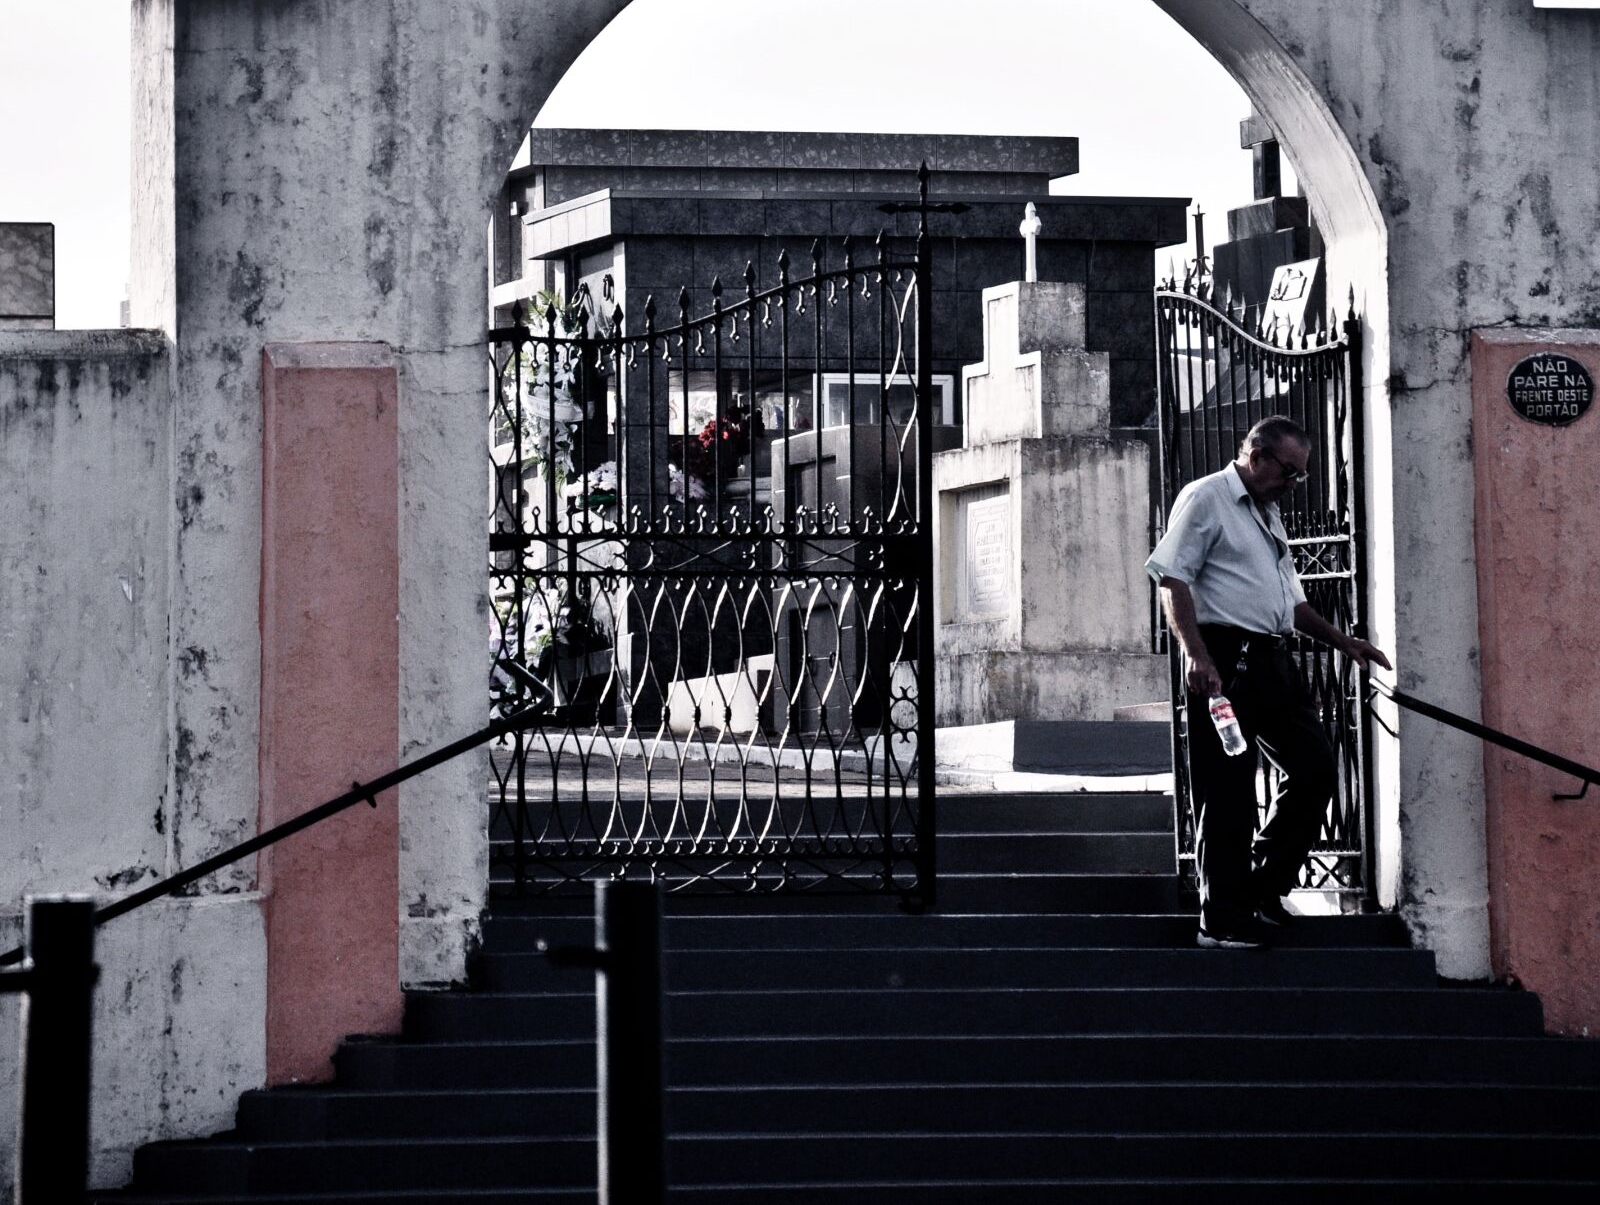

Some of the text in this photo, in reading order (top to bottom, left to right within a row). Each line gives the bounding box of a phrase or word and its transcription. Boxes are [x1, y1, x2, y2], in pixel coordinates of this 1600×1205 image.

[1532, 358, 1568, 374] NÃO
[1514, 374, 1587, 389] PARE NA
[1515, 389, 1590, 403] FRENTE DESTE
[1526, 402, 1579, 416] PORTÃO
